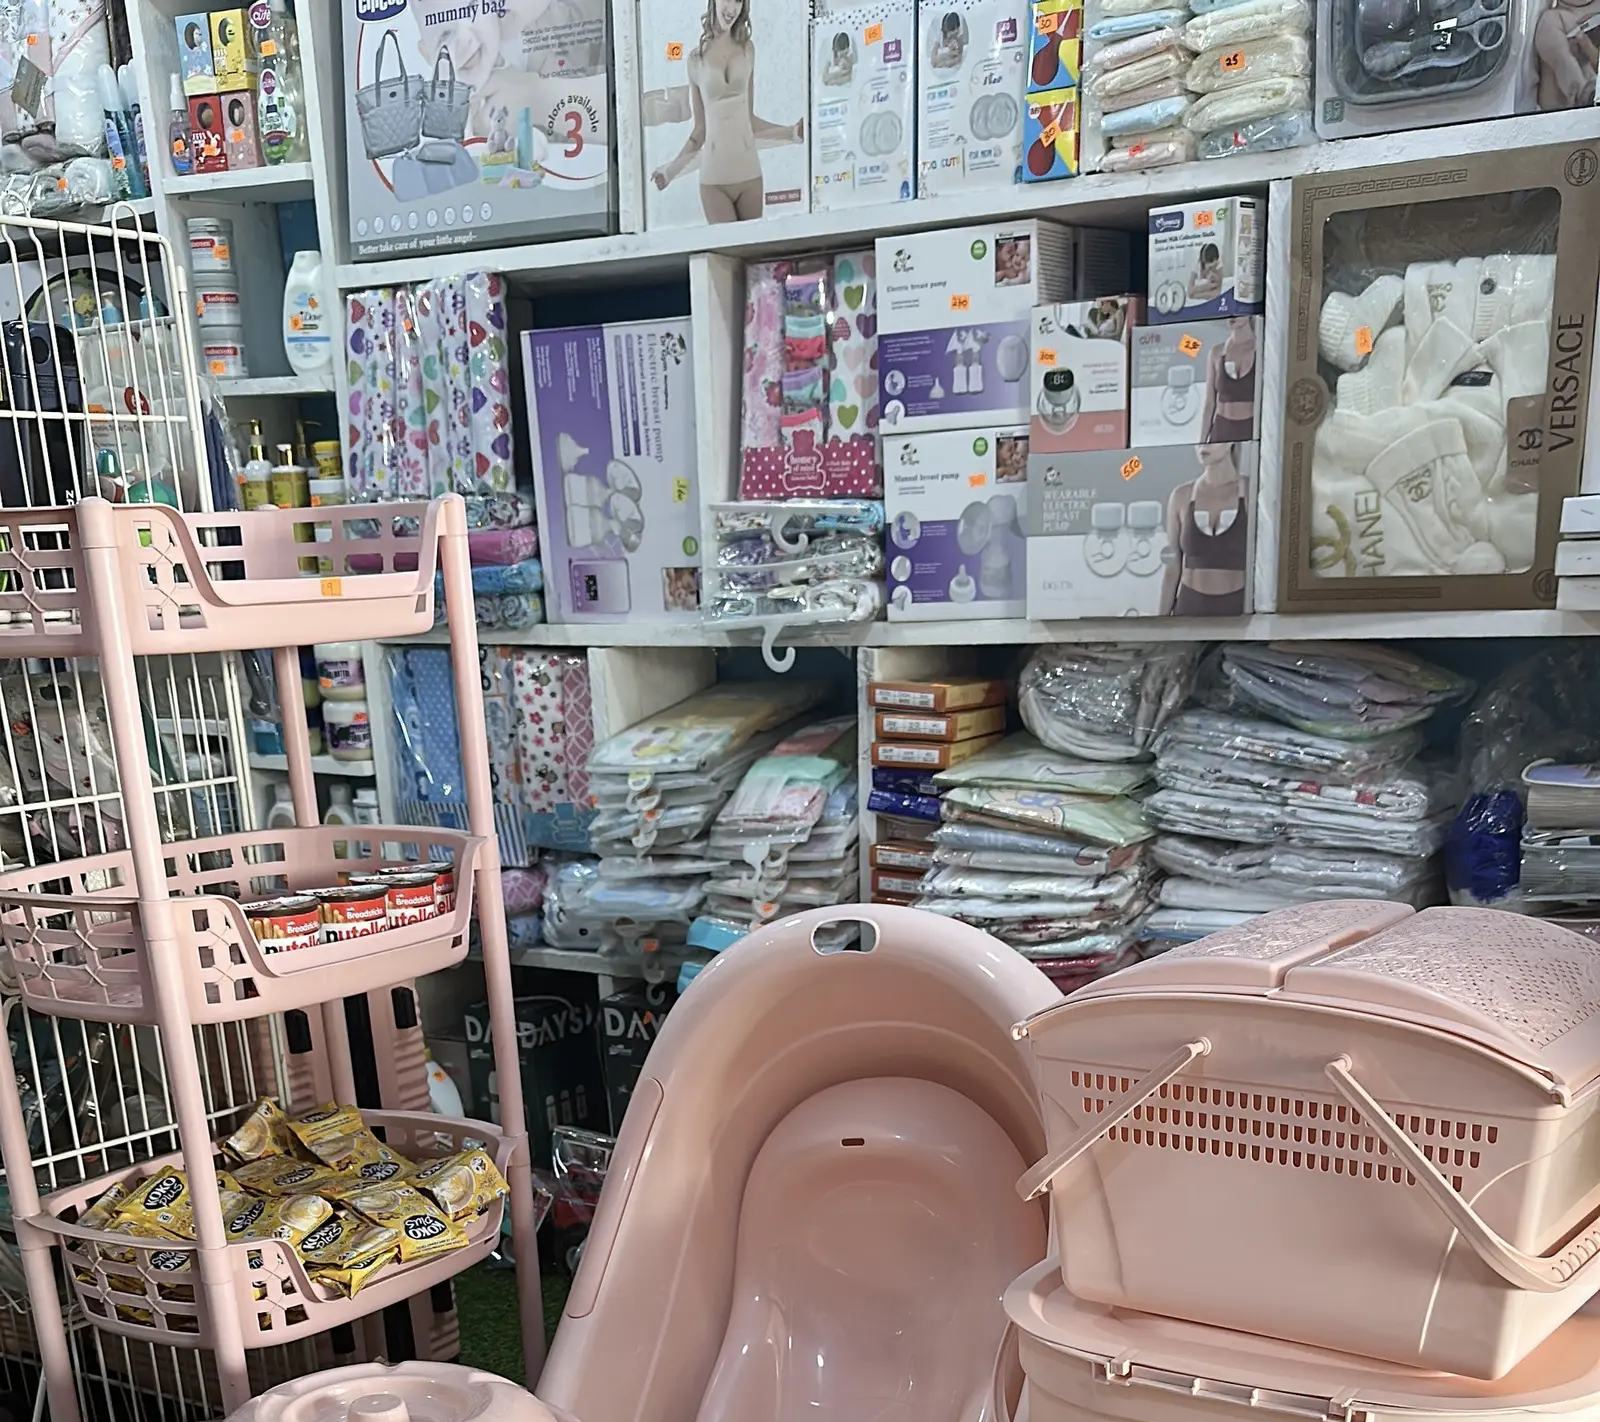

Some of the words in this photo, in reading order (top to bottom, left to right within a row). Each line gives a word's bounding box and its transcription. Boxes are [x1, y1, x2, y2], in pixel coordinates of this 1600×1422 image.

[425, 4, 479, 26] mummy
[482, 0, 506, 18] bag
[1226, 54, 1239, 66] 25
[547, 98, 566, 136] colors
[567, 95, 599, 133] available
[564, 111, 584, 158] 3
[1197, 214, 1210, 226] 50
[647, 333, 657, 383] Electric
[1548, 313, 1585, 453] VERSACE
[651, 386, 661, 425] breast
[653, 427, 664, 463] pump
[1123, 458, 1141, 478] 550
[395, 894, 432, 906] Breadsticks
[346, 907, 384, 920] Breadsticks
[389, 905, 435, 930] utella
[145, 1176, 176, 1206] KOKO
[159, 1183, 183, 1208] plus
[405, 1215, 433, 1229] plus
[408, 1221, 446, 1239] KOKO
